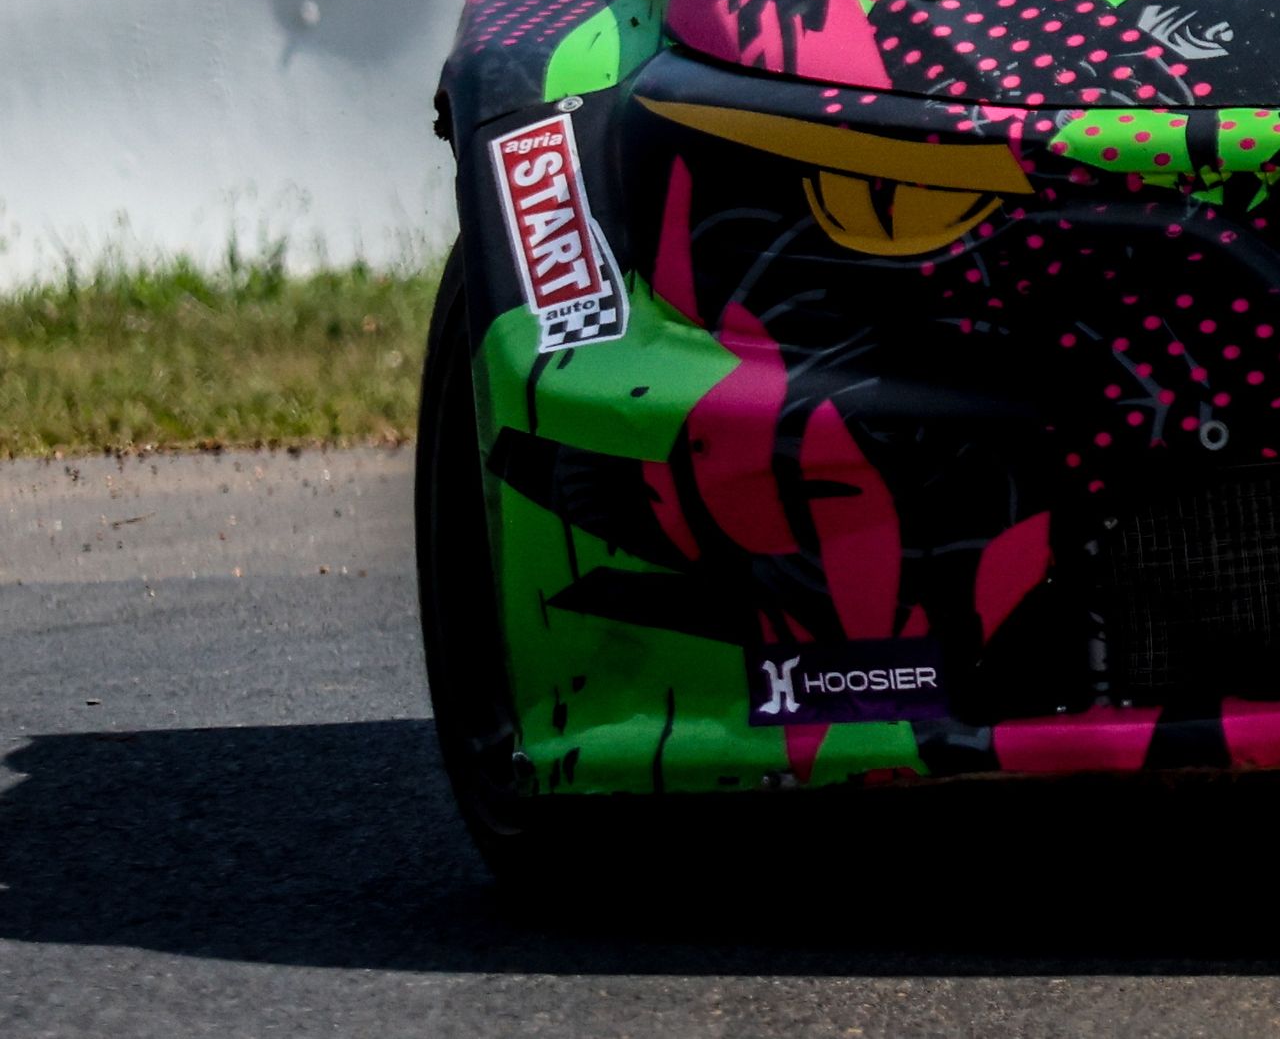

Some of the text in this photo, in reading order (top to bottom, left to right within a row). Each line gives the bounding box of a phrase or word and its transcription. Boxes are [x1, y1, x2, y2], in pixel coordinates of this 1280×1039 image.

[505, 131, 564, 154] agria
[512, 151, 593, 296] START
[545, 298, 596, 321] auto
[803, 667, 938, 693] HOOSIER
